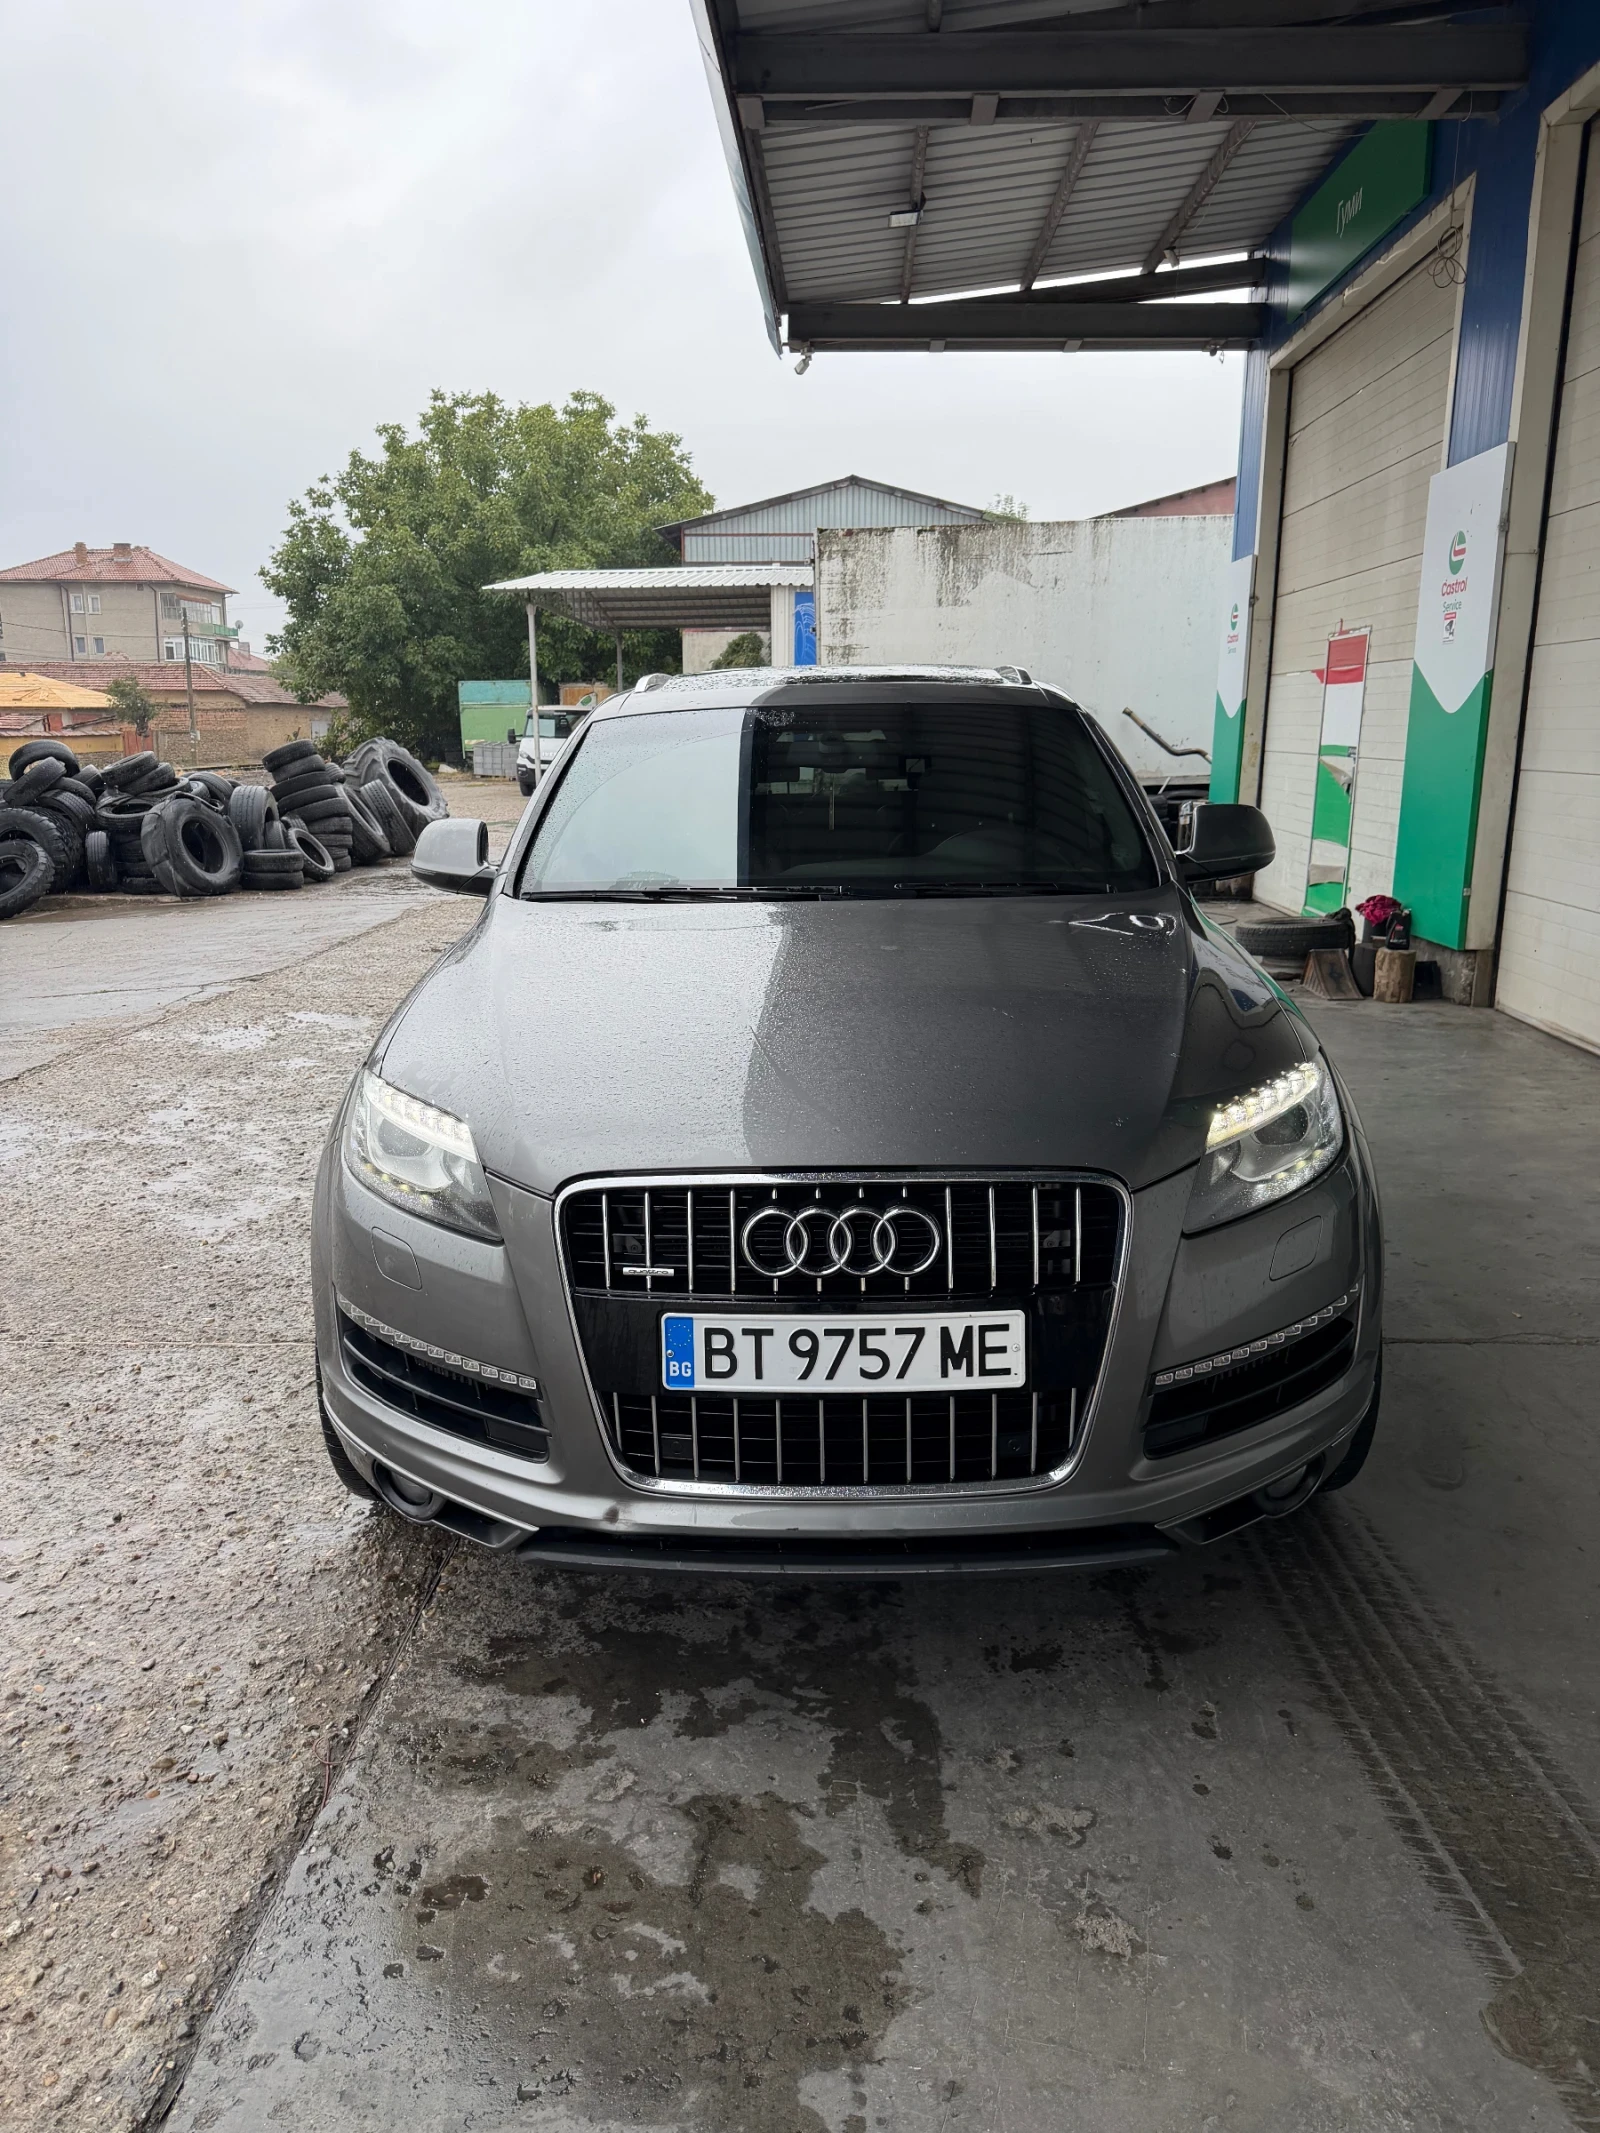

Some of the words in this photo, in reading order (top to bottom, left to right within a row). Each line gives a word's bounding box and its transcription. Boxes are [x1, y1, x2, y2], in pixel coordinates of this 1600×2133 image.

[1336, 187, 1363, 239] Гуми
[1441, 576, 1468, 597] Castrol
[1442, 600, 1462, 612] Service
[704, 1327, 774, 1379] BT
[788, 1327, 926, 1381] 9757
[940, 1323, 1012, 1378] ME
[669, 1361, 692, 1377] BG
